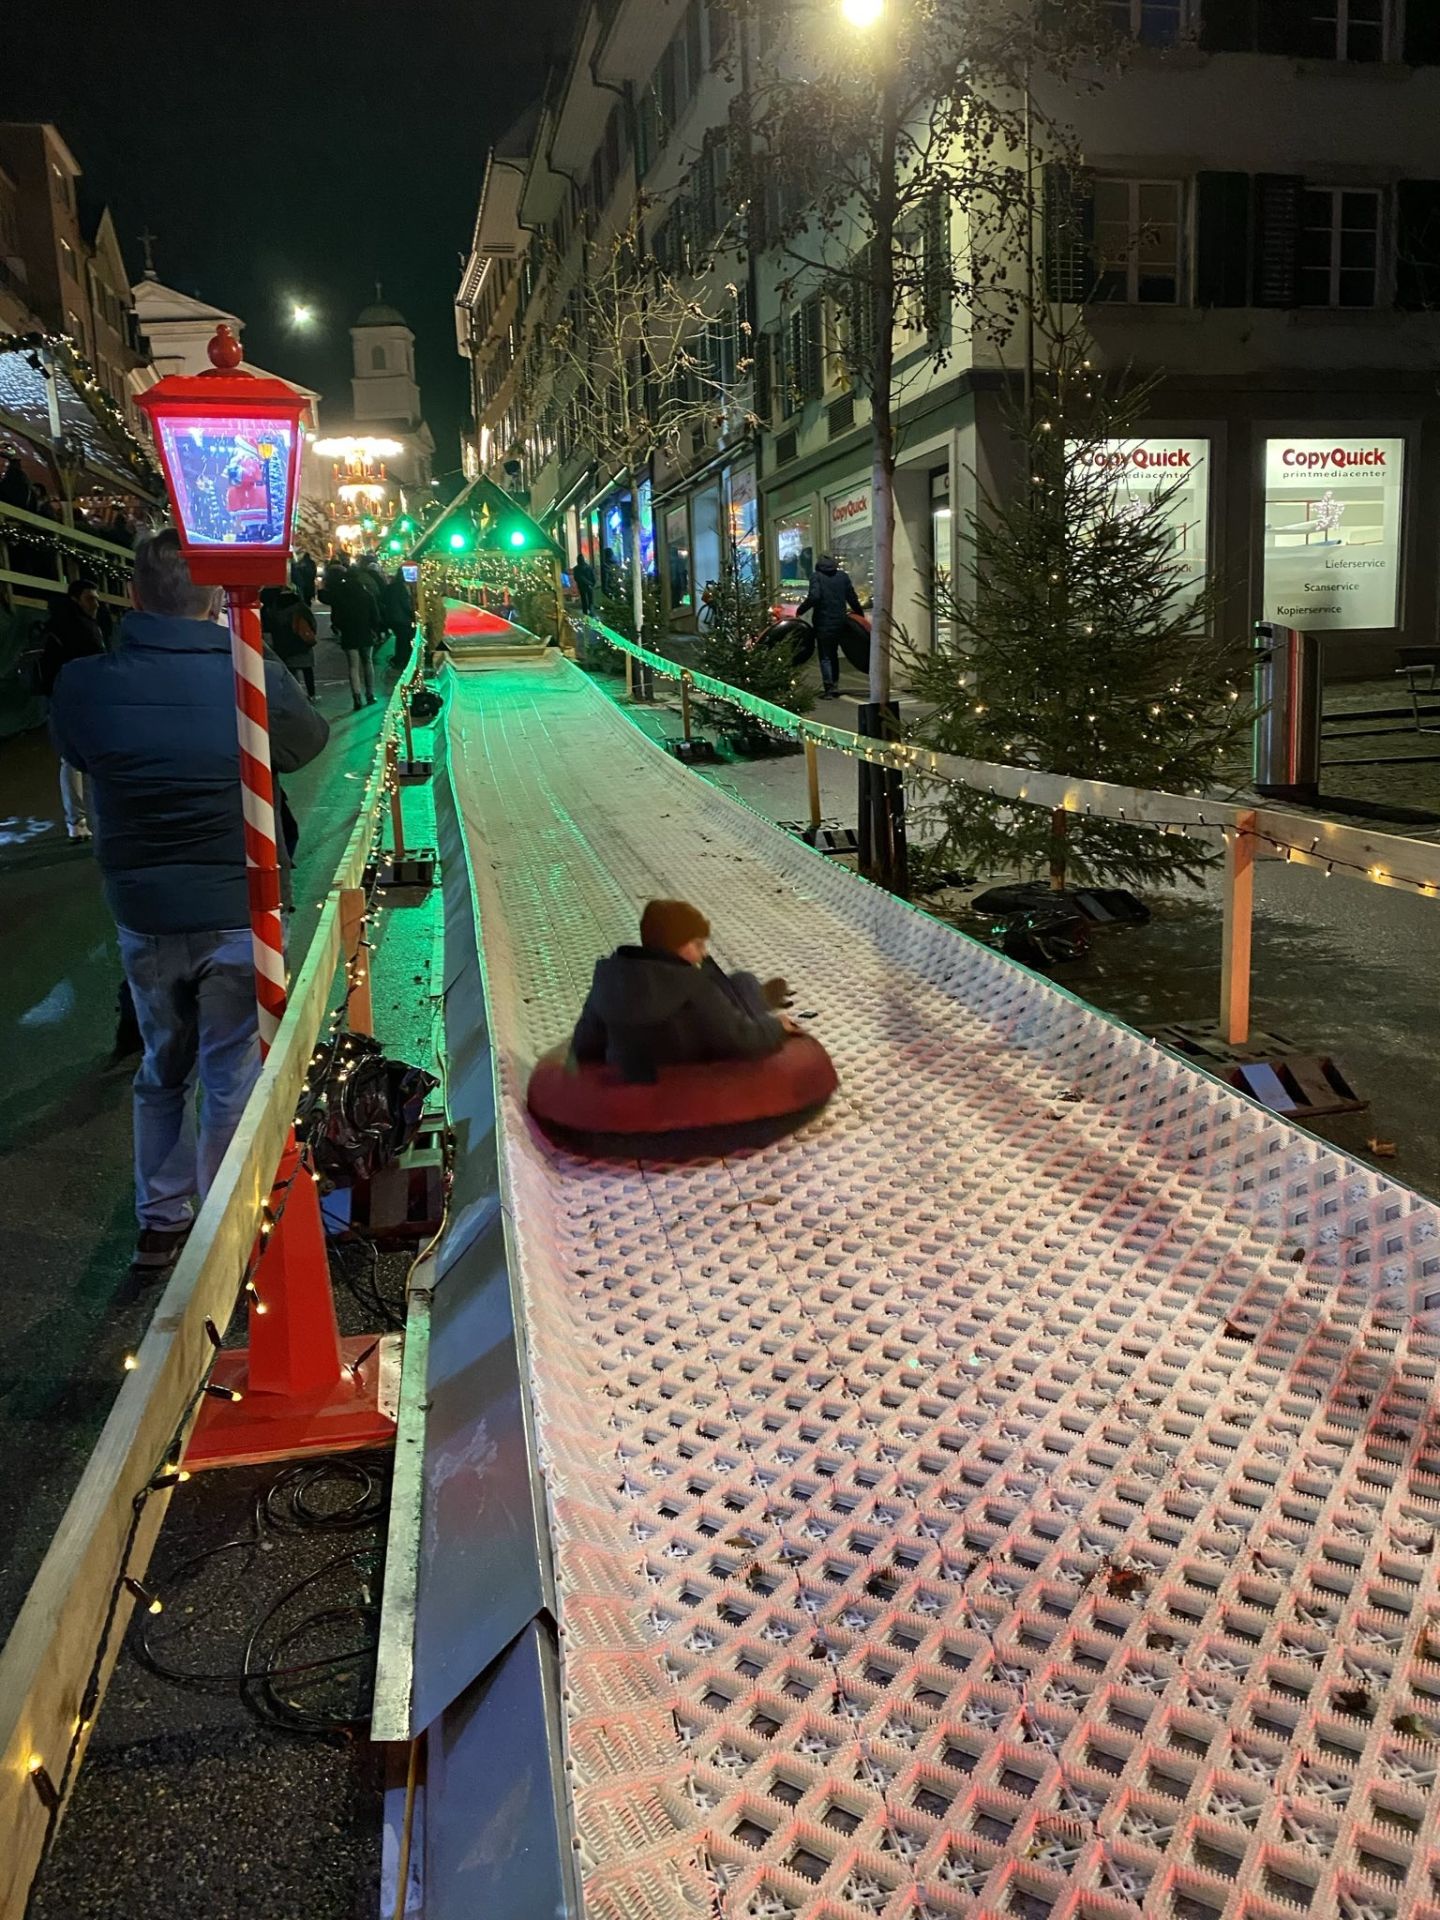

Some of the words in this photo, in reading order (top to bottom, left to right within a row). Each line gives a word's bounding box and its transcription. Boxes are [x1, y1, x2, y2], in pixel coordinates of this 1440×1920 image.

[1282, 448, 1387, 470] CopyQuick
[1283, 470, 1387, 480] printmediacenter
[1325, 559, 1386, 569] Lieferservice
[1304, 583, 1360, 592] Scanservice
[1277, 605, 1342, 617] Kopierservice
